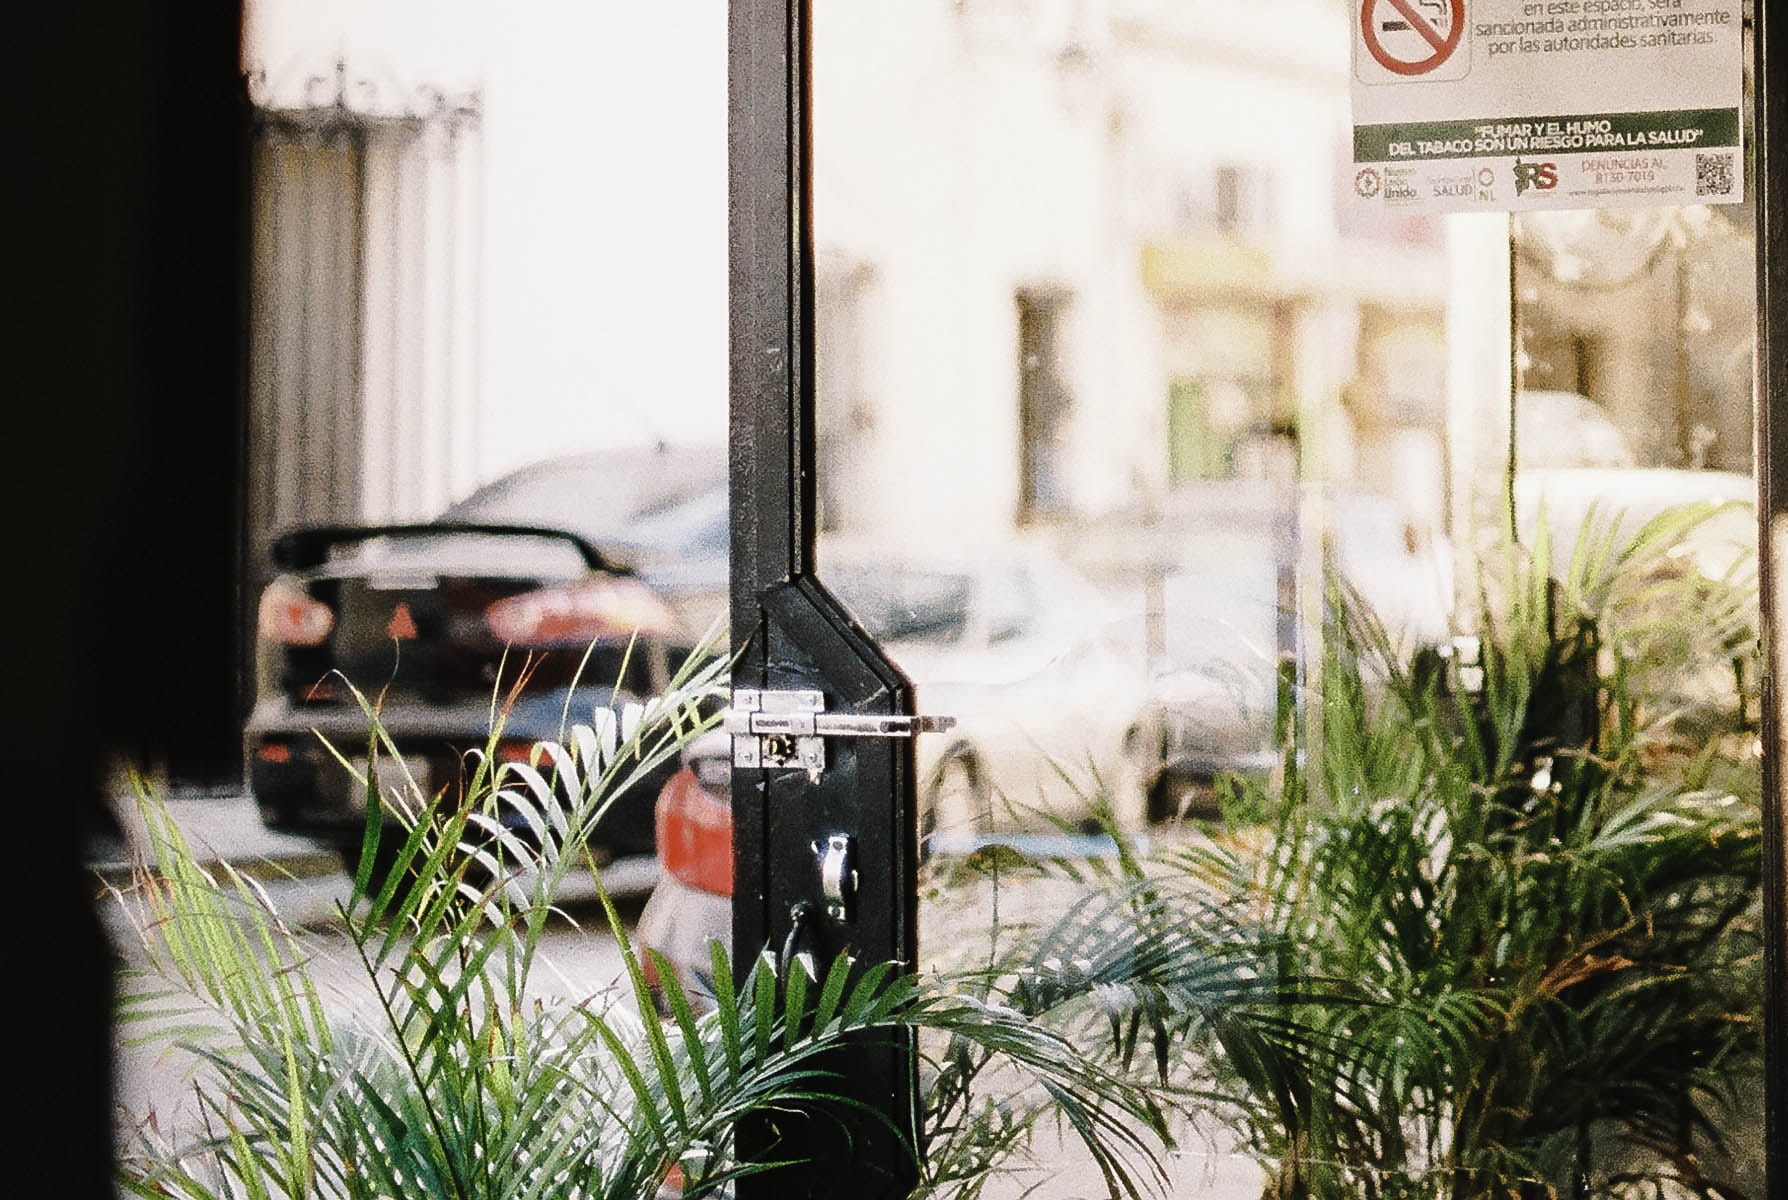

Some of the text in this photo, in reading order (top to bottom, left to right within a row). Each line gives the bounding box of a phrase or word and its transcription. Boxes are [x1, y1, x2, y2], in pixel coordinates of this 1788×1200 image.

[1523, 1, 1544, 16] en
[1476, 8, 1731, 37] sancionada administrativamente
[1488, 39, 1518, 57] por
[1519, 34, 1544, 52] las
[1544, 30, 1638, 52] autoridades
[1534, 122, 1545, 137] Y
[1547, 121, 1565, 137] EL
[1566, 118, 1612, 135] HUMO
[1388, 141, 1416, 157] DEL
[1416, 137, 1473, 155] TABACO
[1474, 136, 1505, 153] SON
[1507, 134, 1529, 151] UN
[1530, 132, 1584, 150] RIESGO
[1585, 131, 1626, 148] PARA
[1627, 130, 1647, 146] LA
[1581, 158, 1649, 173] DENUNCIAS
[1432, 183, 1474, 198] SALUD
